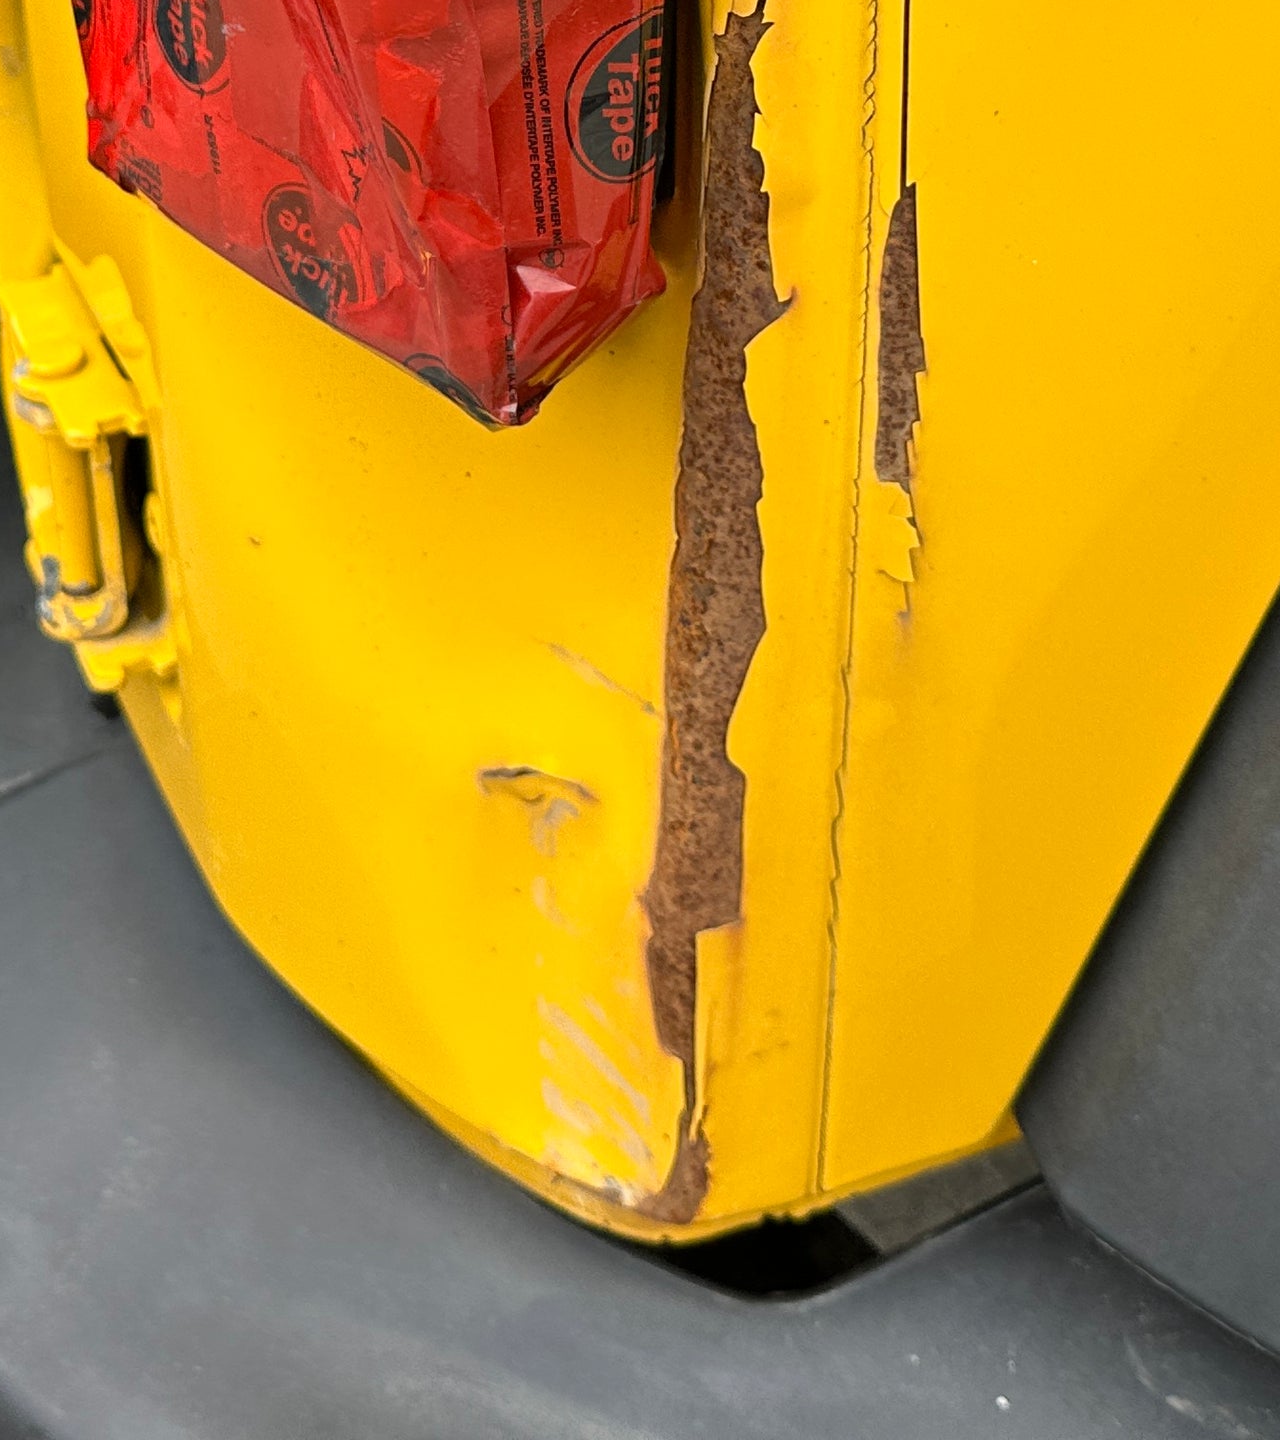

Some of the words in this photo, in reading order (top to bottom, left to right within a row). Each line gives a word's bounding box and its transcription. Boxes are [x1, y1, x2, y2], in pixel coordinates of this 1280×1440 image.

[523, 91, 539, 162] D'INTERTAPE
[540, 99, 551, 114] OF
[602, 52, 639, 162] Tape
[541, 116, 556, 176] INTERTAPE
[530, 164, 544, 214] POLYMER
[547, 177, 561, 227] POLYMER
[535, 216, 546, 237] INC.
